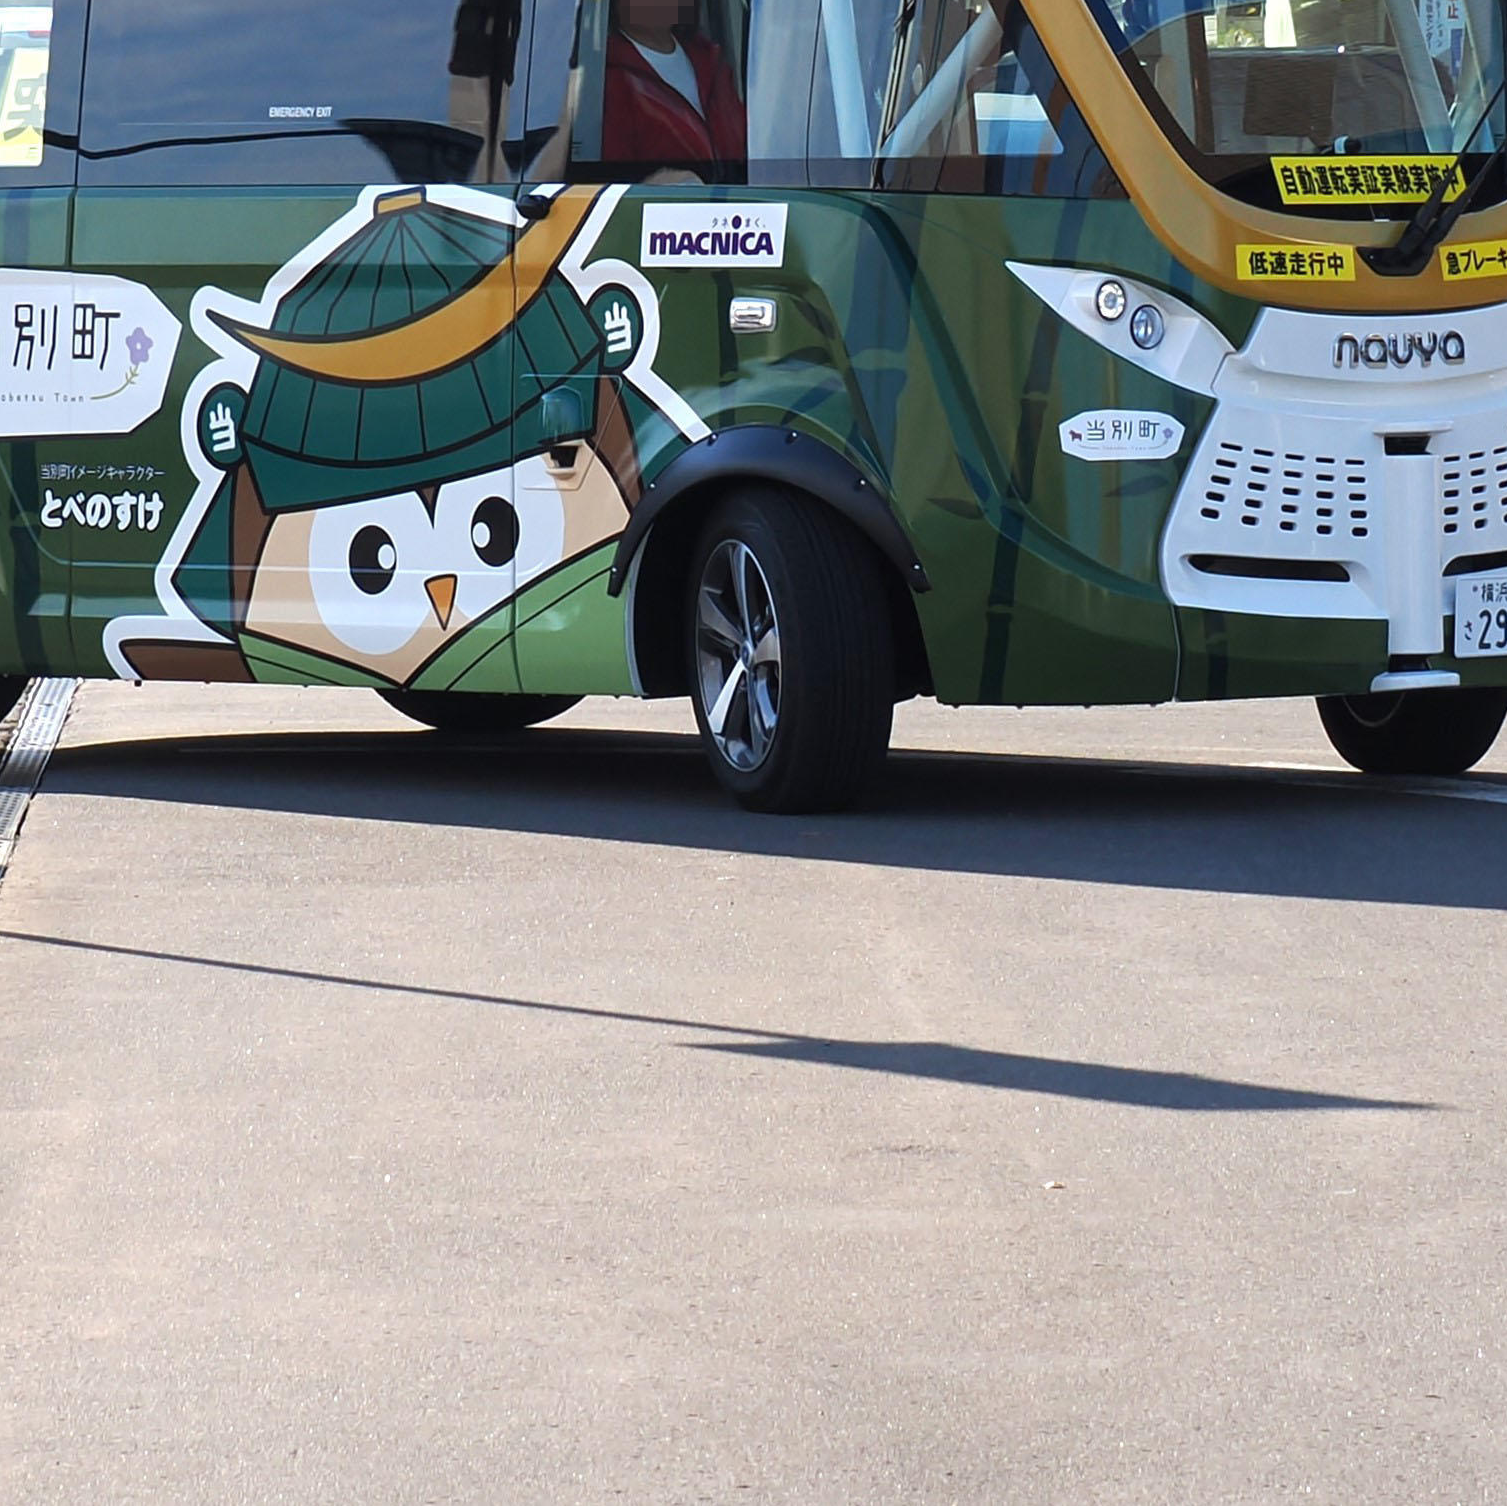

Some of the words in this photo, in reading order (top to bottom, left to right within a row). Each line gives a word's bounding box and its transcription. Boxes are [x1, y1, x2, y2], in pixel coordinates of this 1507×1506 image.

[1280, 164, 1459, 197] 自動運転実証実験実施中
[649, 231, 774, 256] MACNICA
[1248, 251, 1345, 277] 低速走行中
[604, 301, 632, 353] 当
[208, 402, 237, 453] 当
[1086, 419, 1161, 441] 当別町
[40, 464, 166, 482] 当別町イメージキャラクター
[39, 489, 165, 532] とべのすけ
[1464, 620, 1473, 641] さ
